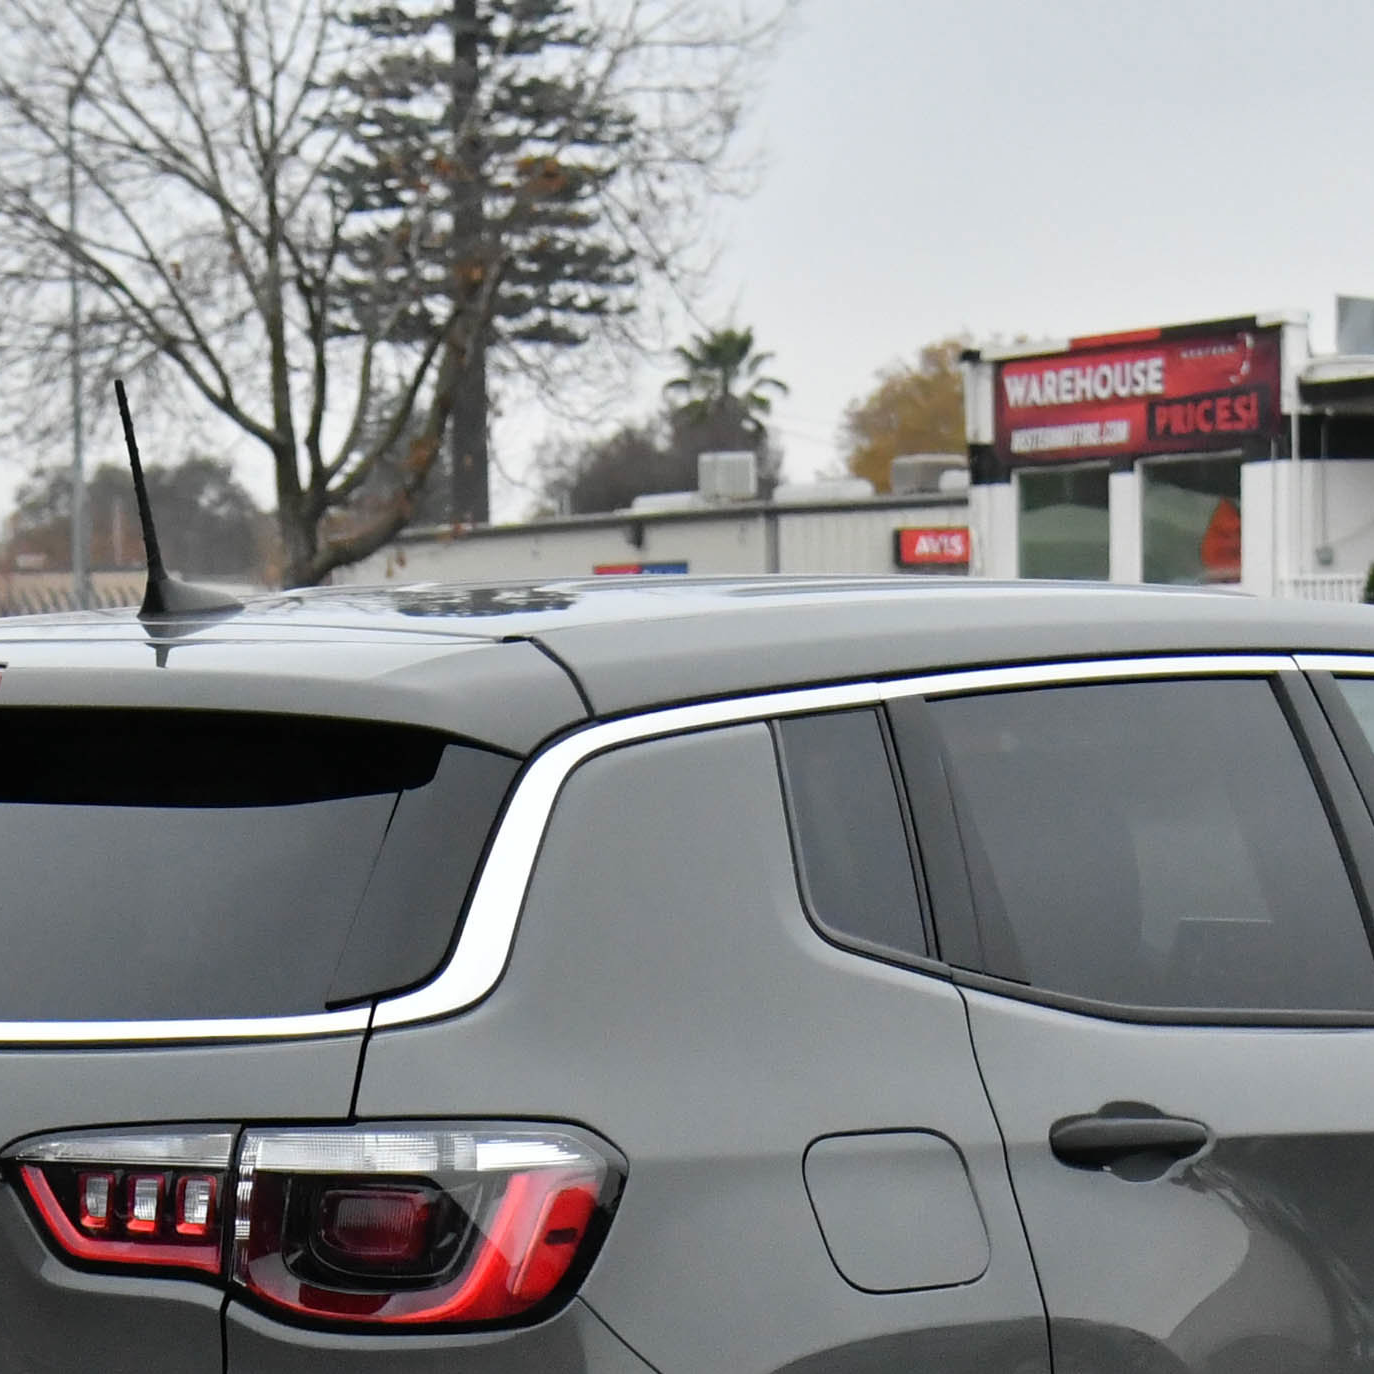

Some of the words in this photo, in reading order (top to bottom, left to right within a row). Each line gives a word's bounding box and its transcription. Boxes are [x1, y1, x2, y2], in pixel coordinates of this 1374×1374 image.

[1004, 356, 1165, 408] WAREHOUSE
[1154, 392, 1259, 436] PRICES!
[915, 533, 964, 556] AVIS
